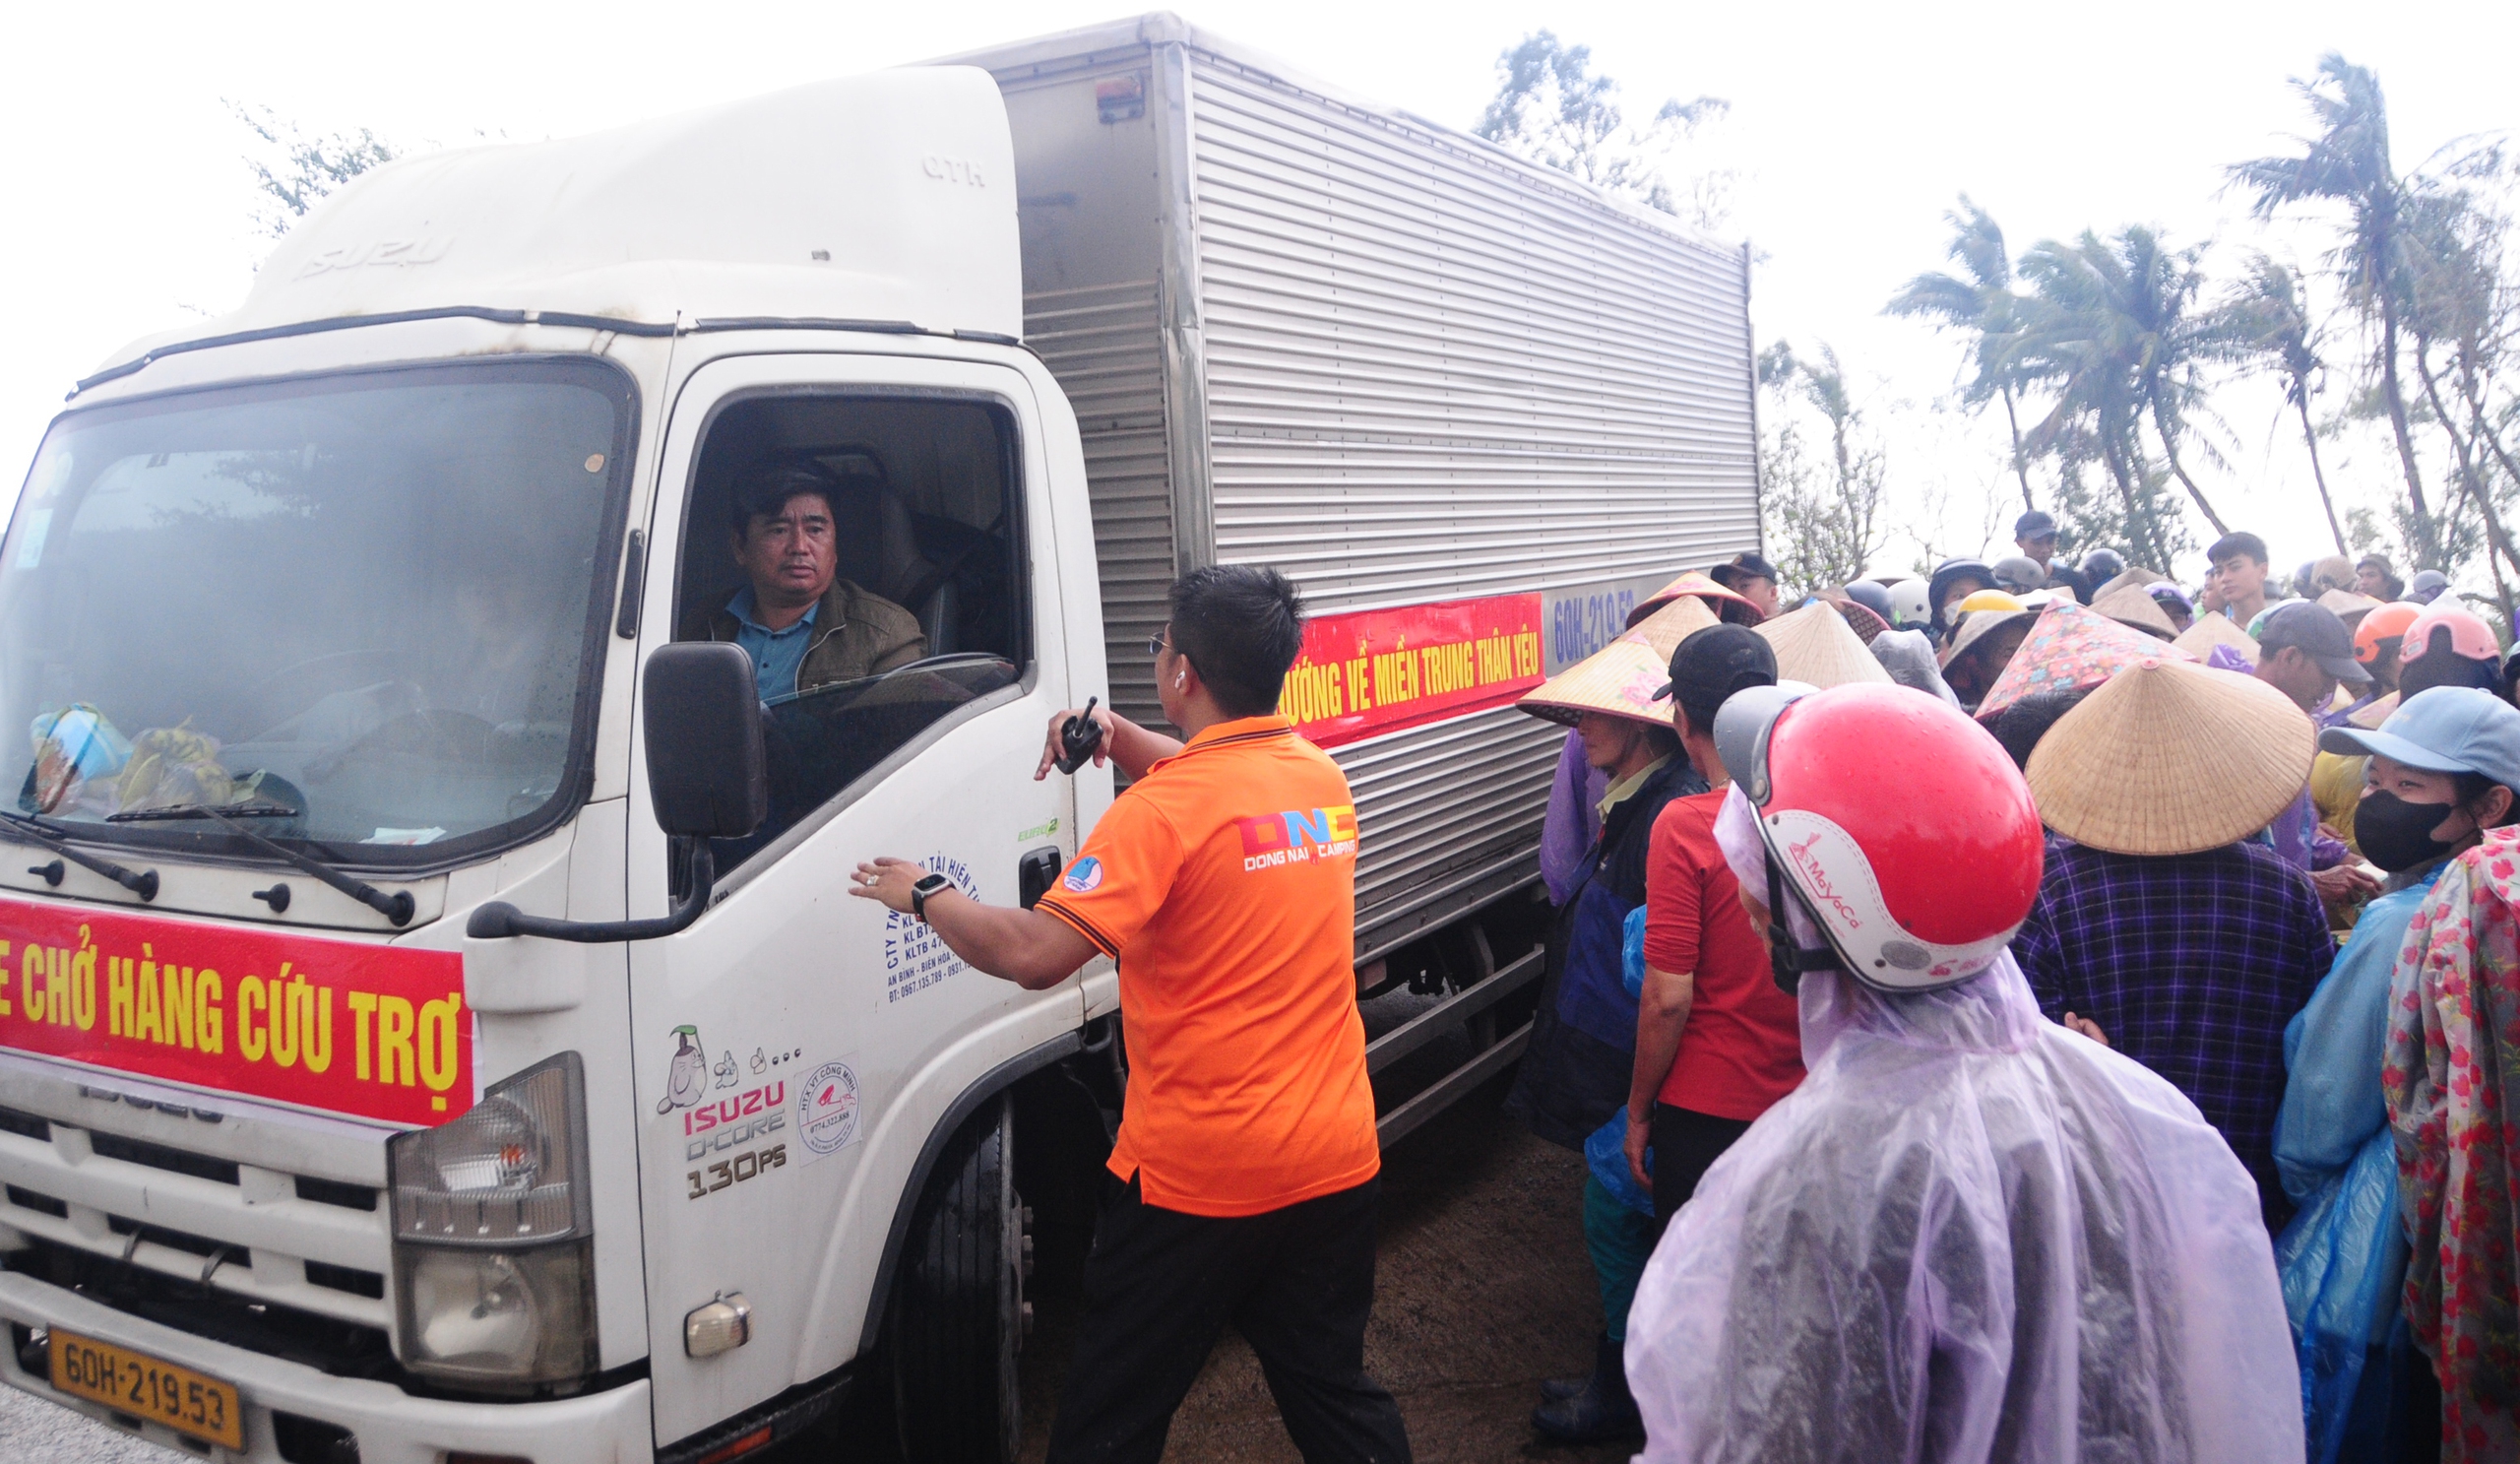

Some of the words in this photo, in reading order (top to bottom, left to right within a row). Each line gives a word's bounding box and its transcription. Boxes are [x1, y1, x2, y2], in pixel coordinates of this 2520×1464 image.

[1346, 639, 1371, 713] VỀ
[1373, 634, 1419, 707] MIỀN
[1421, 641, 1475, 696] TRUNG
[1477, 626, 1513, 686] THÂN
[1513, 623, 1540, 677] YÊU
[1244, 851, 1286, 872] DONG
[1287, 847, 1309, 862] NAI
[1317, 839, 1355, 858] CAMPING
[886, 938, 899, 970] CTY
[22, 923, 97, 1031] CHỞ
[108, 942, 223, 1054] HÀNG
[237, 962, 332, 1073] CỨU
[348, 990, 461, 1112] TRỢ
[684, 1080, 785, 1136] ISUZU
[65, 1343, 224, 1430] 60H-219.53
